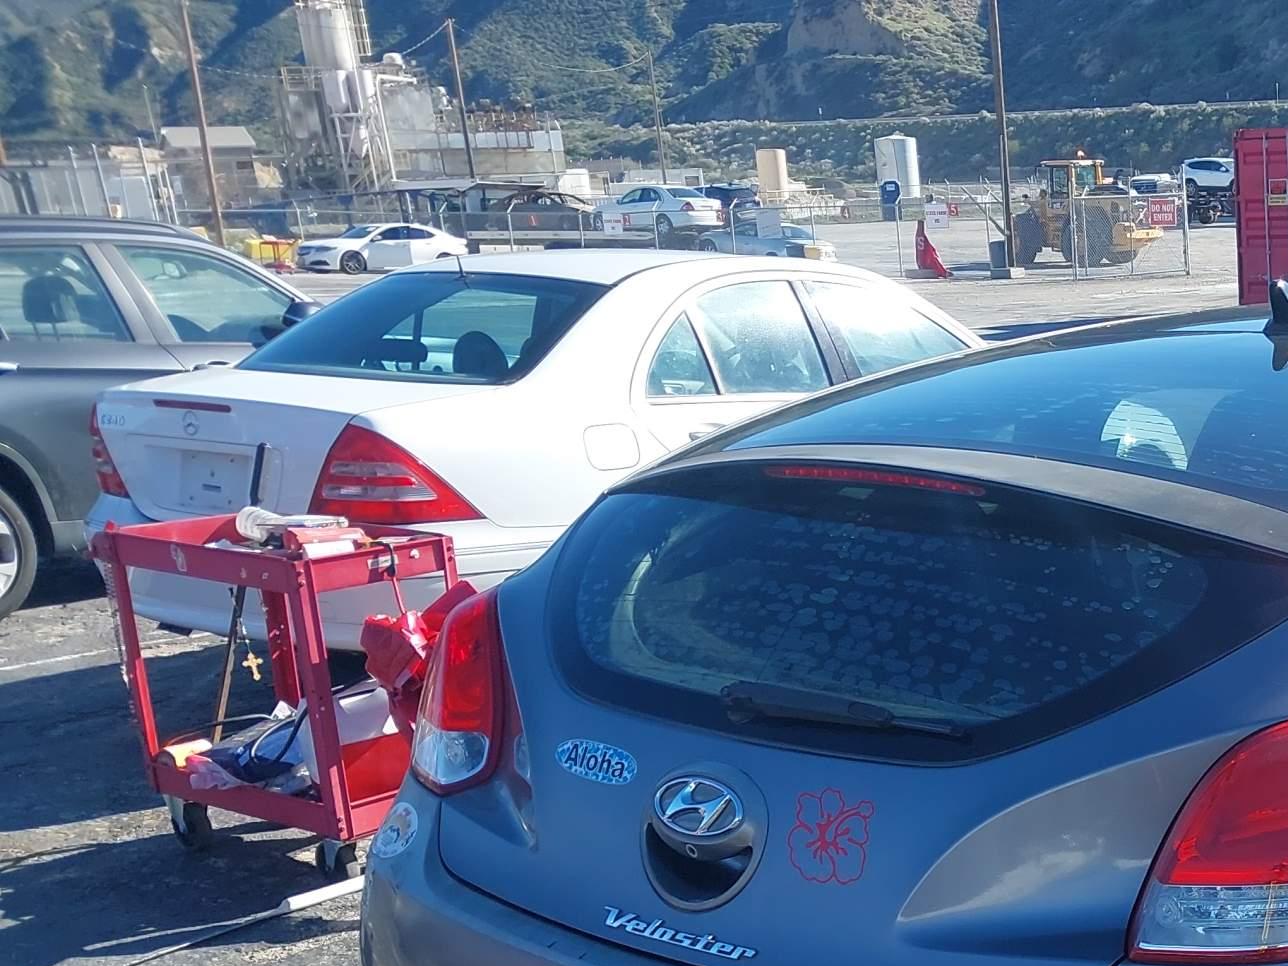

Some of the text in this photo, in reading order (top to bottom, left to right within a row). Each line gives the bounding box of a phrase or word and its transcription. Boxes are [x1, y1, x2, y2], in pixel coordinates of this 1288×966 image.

[950, 204, 957, 215] 5
[1151, 203, 1174, 212] DO NOT
[1153, 213, 1173, 222] ENTER
[564, 743, 625, 779] Aloha
[604, 905, 757, 960] Veloster
